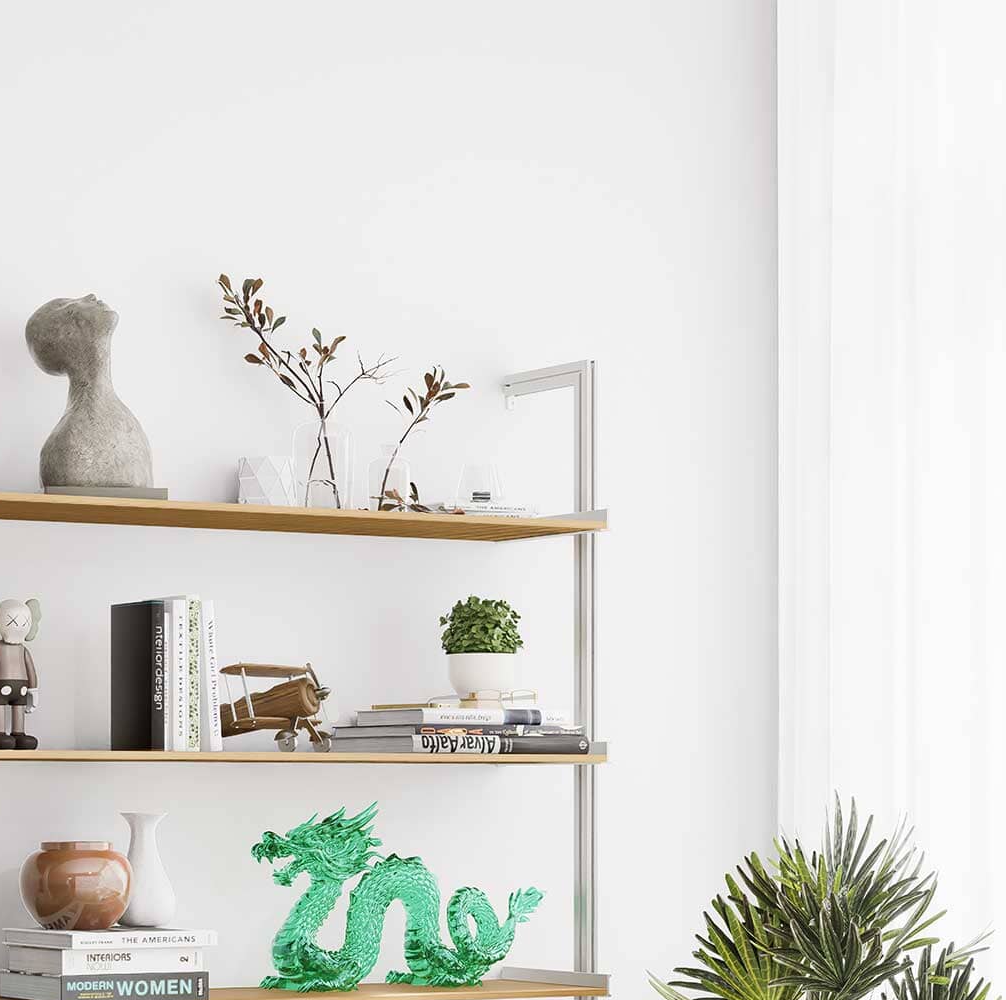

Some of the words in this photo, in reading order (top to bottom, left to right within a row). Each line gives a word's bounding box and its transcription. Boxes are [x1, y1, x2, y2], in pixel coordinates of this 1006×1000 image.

[154, 612, 162, 711] nteriordesign
[459, 736, 496, 754] Alvar
[121, 936, 138, 944] THE
[141, 935, 196, 944] AMERICANS
[86, 952, 132, 962] INTERIORS
[66, 980, 114, 992] MODERN
[116, 979, 193, 996] WOMEN
